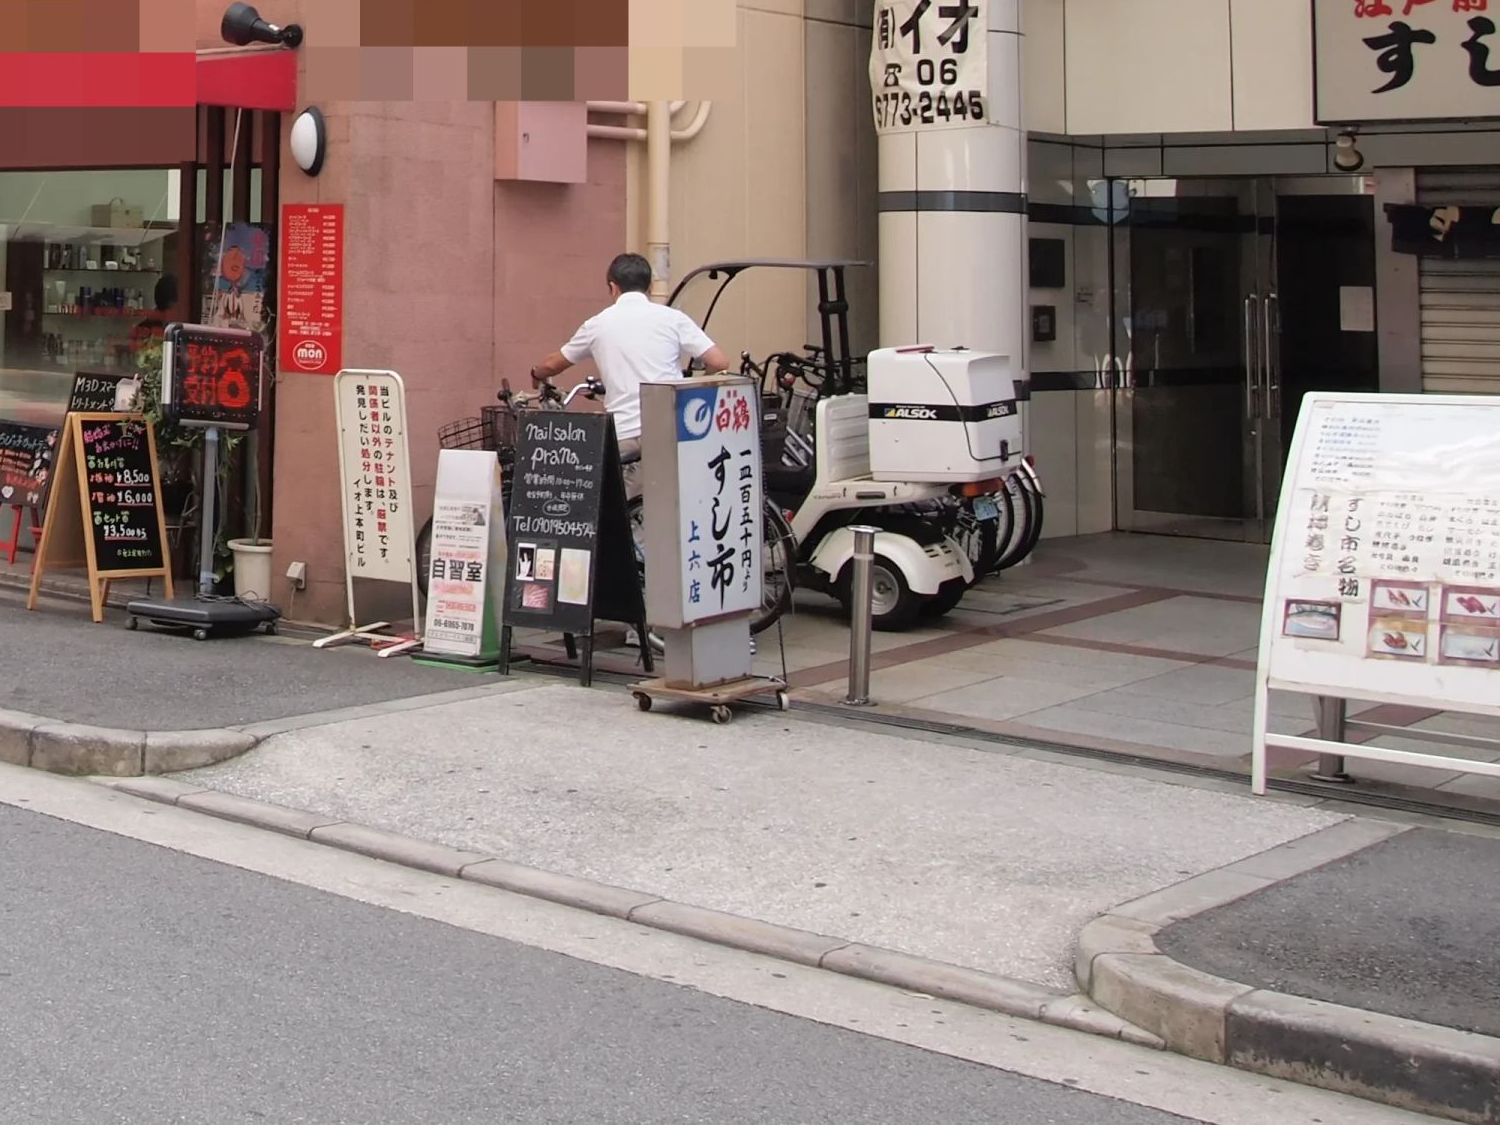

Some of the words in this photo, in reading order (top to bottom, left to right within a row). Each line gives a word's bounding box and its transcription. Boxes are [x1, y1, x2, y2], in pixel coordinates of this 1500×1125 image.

[916, 58, 959, 86] 06
[1361, 15, 1500, 94] すし
[297, 348, 323, 359] mon
[355, 384, 374, 515] 発見しだい処分します。
[379, 384, 399, 514] 当ビルのテナント及び
[553, 421, 587, 442] salon
[895, 408, 938, 419] ALSOK
[352, 478, 367, 568] イオ上本町ビル
[687, 519, 701, 604] 上六店
[706, 444, 737, 610] すし市
[431, 557, 483, 583] 自習室
